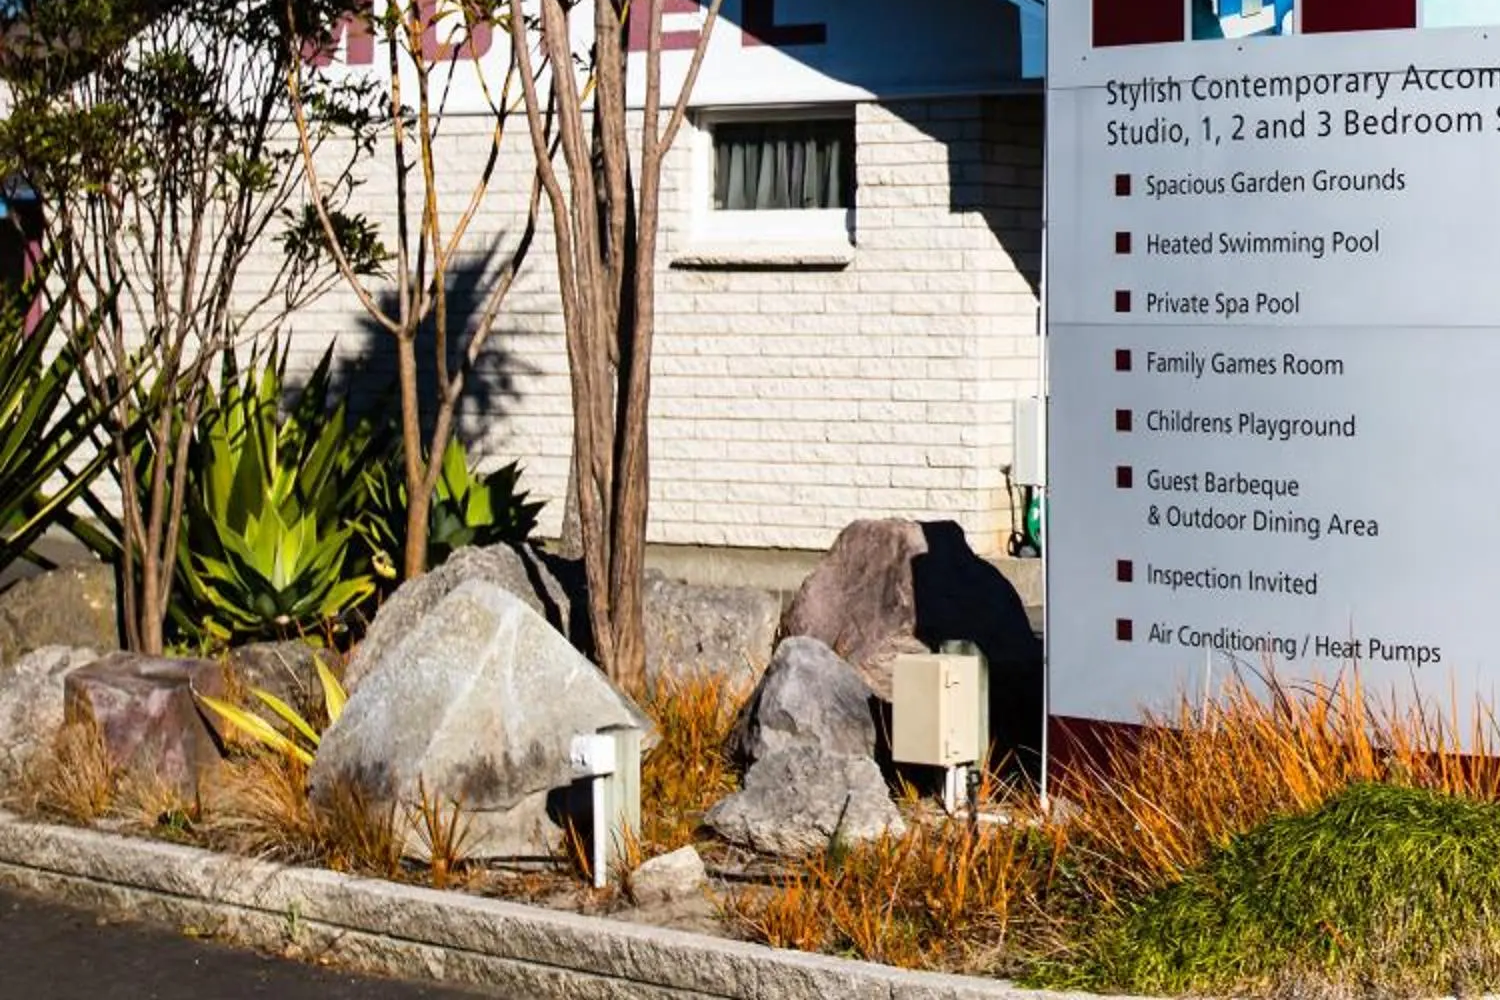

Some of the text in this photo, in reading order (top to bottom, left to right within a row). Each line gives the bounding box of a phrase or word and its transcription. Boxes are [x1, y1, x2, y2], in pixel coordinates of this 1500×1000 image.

[1106, 76, 1182, 111] Stylish
[1191, 72, 1391, 102] Contemporary
[1106, 117, 1190, 146] Studio,
[1202, 116, 1221, 146] 1,
[1231, 114, 1245, 141] 2
[1255, 111, 1306, 139] and
[1317, 110, 1332, 137] 3
[1344, 106, 1483, 136] Bedroom
[1146, 168, 1406, 200] Spacious Garden Grounds
[1146, 230, 1380, 259] Heated Swimming Pool
[1146, 291, 1300, 318] Private Spa Pool
[1146, 351, 1345, 379] Family Games Room
[1146, 410, 1356, 441] Childrens Playground
[1146, 468, 1300, 500] Guest Barbeque
[1148, 504, 1380, 540] & Outdoor Dining Area
[1147, 563, 1318, 595] Inspection Invited
[1149, 622, 1172, 645] Air
[1177, 625, 1297, 660] Conditioning
[1315, 636, 1363, 660] Heat
[1369, 638, 1442, 667] Pumps
